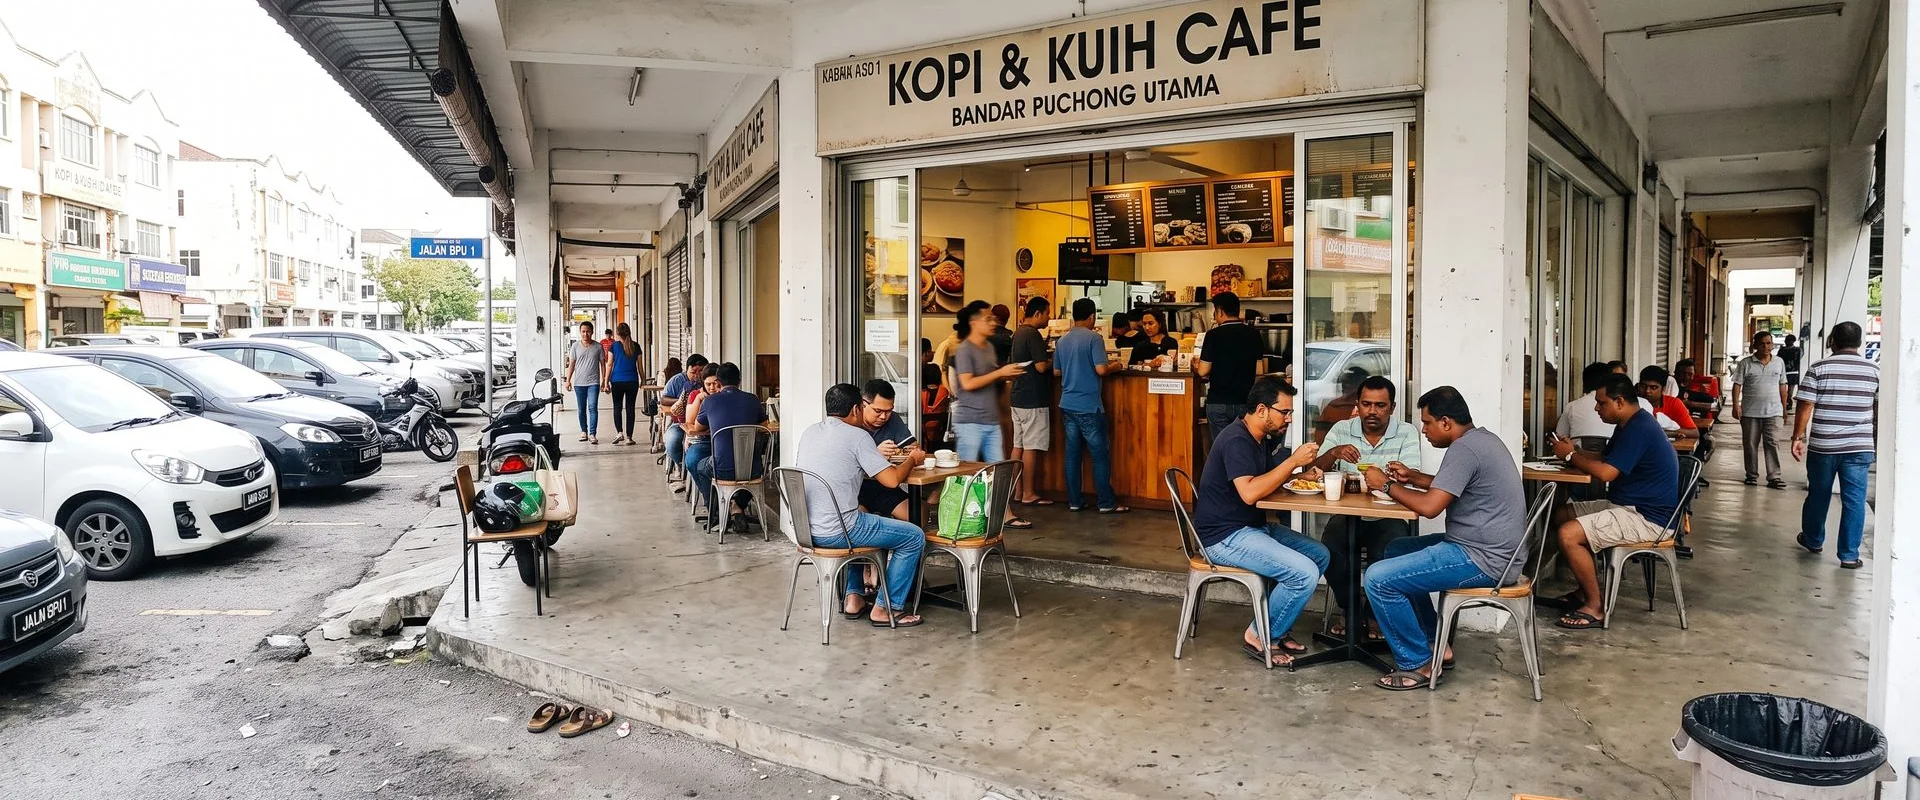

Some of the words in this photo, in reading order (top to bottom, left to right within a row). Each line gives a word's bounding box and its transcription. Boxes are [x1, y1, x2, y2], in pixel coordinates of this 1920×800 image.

[889, 50, 982, 106] KOPI
[1000, 43, 1031, 90] &
[1049, 20, 1155, 84] KUIH
[1176, 0, 1321, 64] CAFE
[952, 99, 1025, 127] BANDAR
[1033, 84, 1136, 117] PUCHONG
[1144, 74, 1220, 103] UTAMA
[746, 106, 764, 157] CAFE
[419, 245, 447, 256] JALAN
[449, 245, 467, 256] BPU
[471, 246, 475, 256] 1
